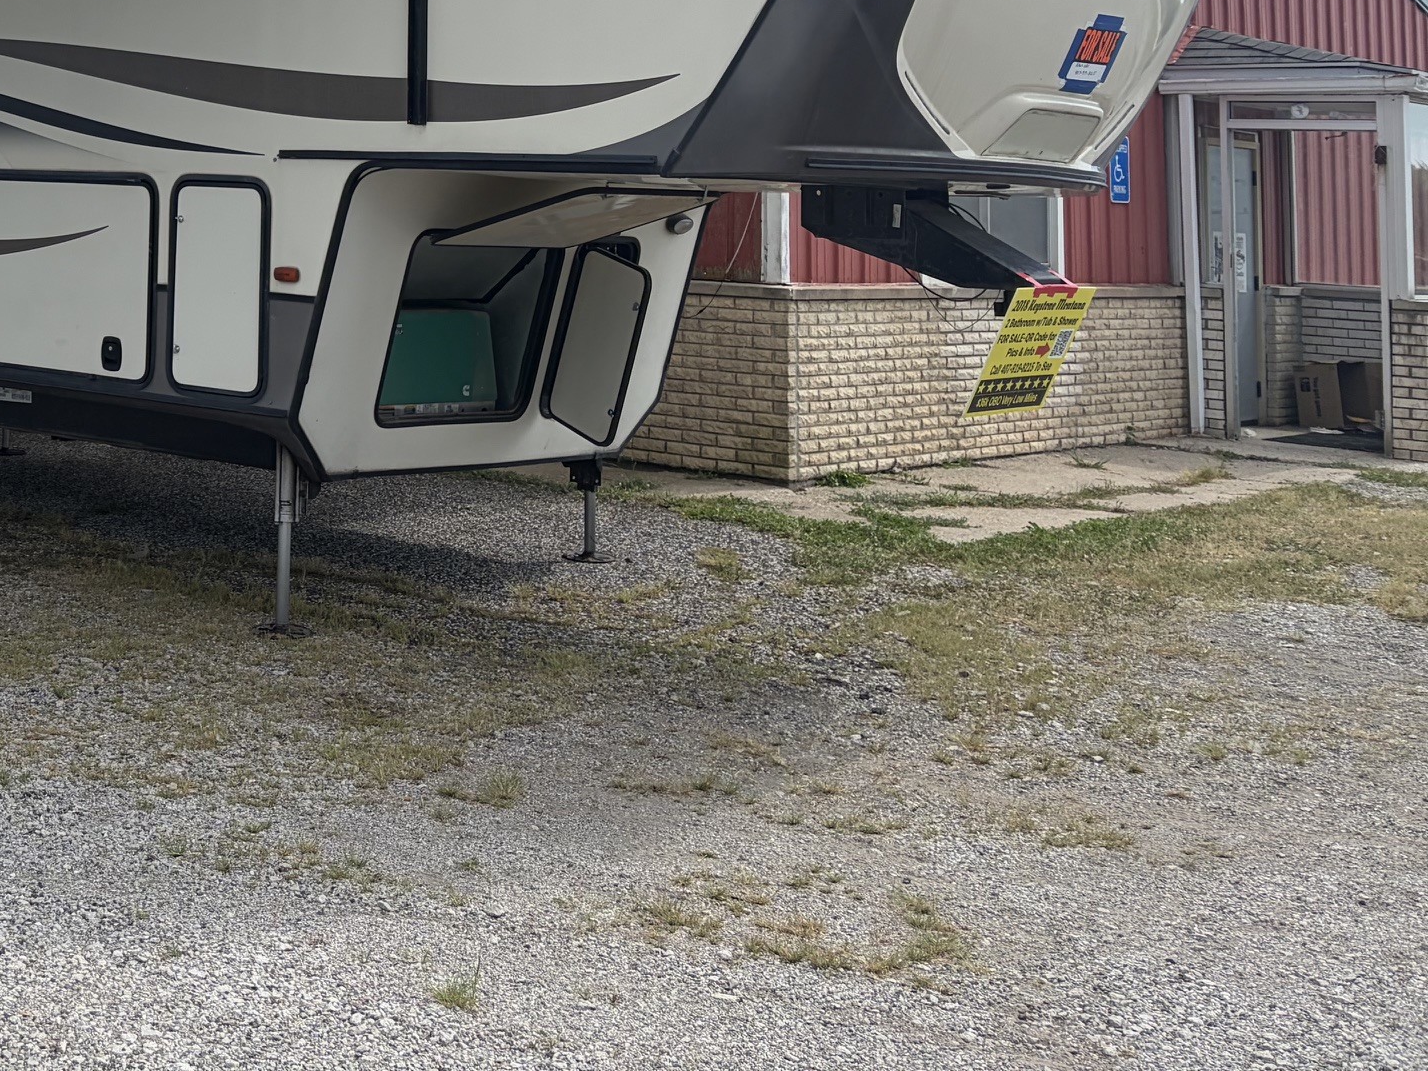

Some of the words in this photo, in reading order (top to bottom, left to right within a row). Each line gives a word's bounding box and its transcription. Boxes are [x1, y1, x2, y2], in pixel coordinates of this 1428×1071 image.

[1075, 29, 1102, 61] FOR
[1093, 30, 1121, 64] SALE
[1012, 300, 1031, 312] 2018
[1028, 299, 1057, 314] Keystone
[1056, 298, 1086, 311] Montana
[1005, 319, 1011, 328] 2
[1009, 318, 1036, 328] Bathroom
[1036, 316, 1054, 327] w/Tub
[1053, 316, 1059, 326] &
[1058, 316, 1079, 326] Shower
[997, 334, 1010, 344] FOR
[1009, 332, 1035, 343] SALE-QR
[1034, 331, 1048, 342] Code
[1047, 331, 1058, 341] for
[1006, 347, 1018, 357] Pics
[1018, 347, 1023, 357] &
[1023, 346, 1035, 356] Info
[990, 364, 1002, 375] Call
[1034, 361, 1043, 371] To
[1041, 361, 1053, 371] See
[1001, 394, 1013, 406] Very
[1012, 393, 1024, 404] Low
